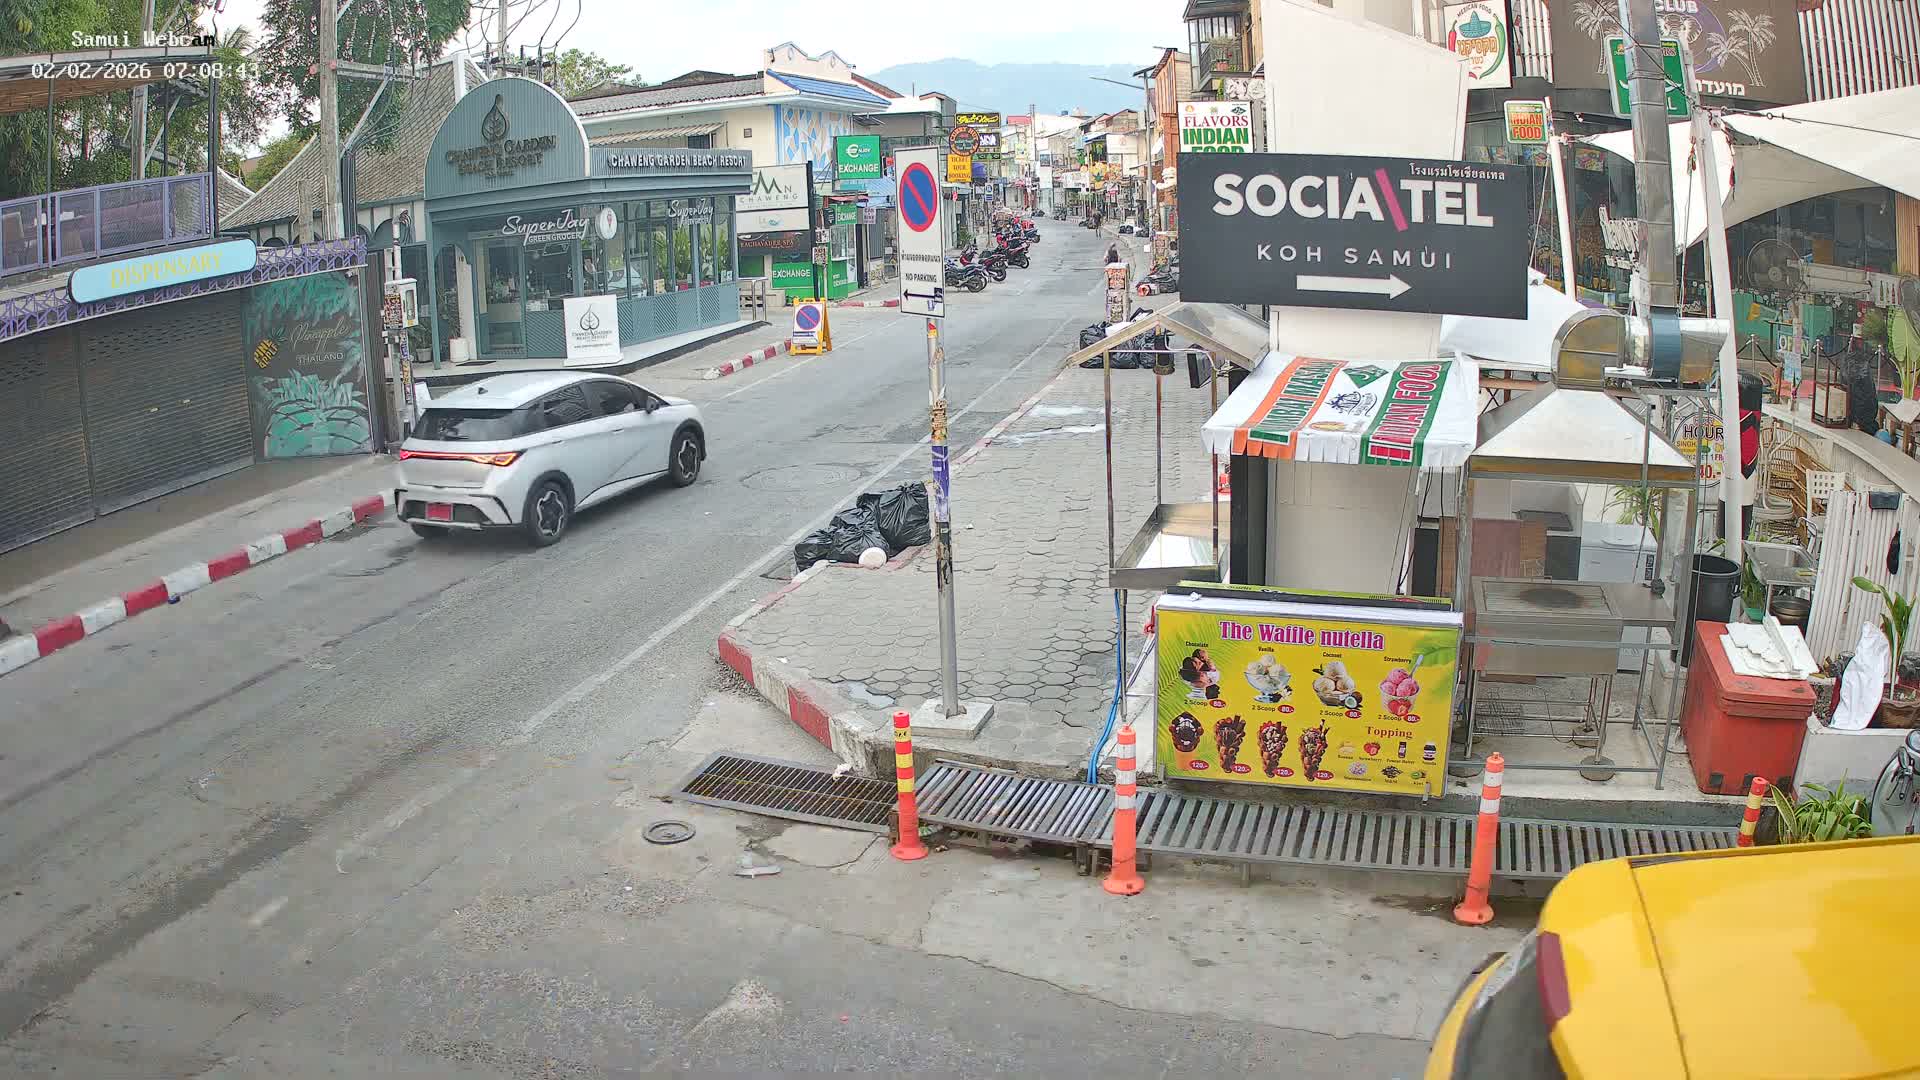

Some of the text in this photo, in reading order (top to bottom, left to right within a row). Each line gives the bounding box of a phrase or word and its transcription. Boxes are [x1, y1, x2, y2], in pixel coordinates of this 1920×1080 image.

[1184, 115, 1249, 128] FLAVORS
[1511, 112, 1542, 126] INDIAN
[1182, 127, 1249, 145] INDIAN
[1512, 126, 1542, 139] FOOD
[503, 135, 557, 153] GARDEN
[610, 154, 747, 168] CHAWENG GARDEN BEACH RESORT
[838, 163, 879, 173] EXCHANGE
[528, 234, 551, 243] GREEN
[1257, 244, 1452, 269] KOH SAMUI
[111, 250, 223, 289] DISPENSARY
[772, 268, 811, 278] EXCHANGE
[914, 273, 937, 283] PARKING
[1779, 334, 1809, 357] ON
[296, 351, 344, 366] THAILAND
[1367, 363, 1442, 463] INDIAN FOOD
[1683, 425, 1724, 440] HOUR
[1219, 620, 1385, 650] The Waffle nutella
[1384, 656, 1412, 664] Strawberry
[1190, 699, 1208, 707] Scoop
[1324, 710, 1344, 718] Scoop
[1367, 726, 1413, 740] Topping
